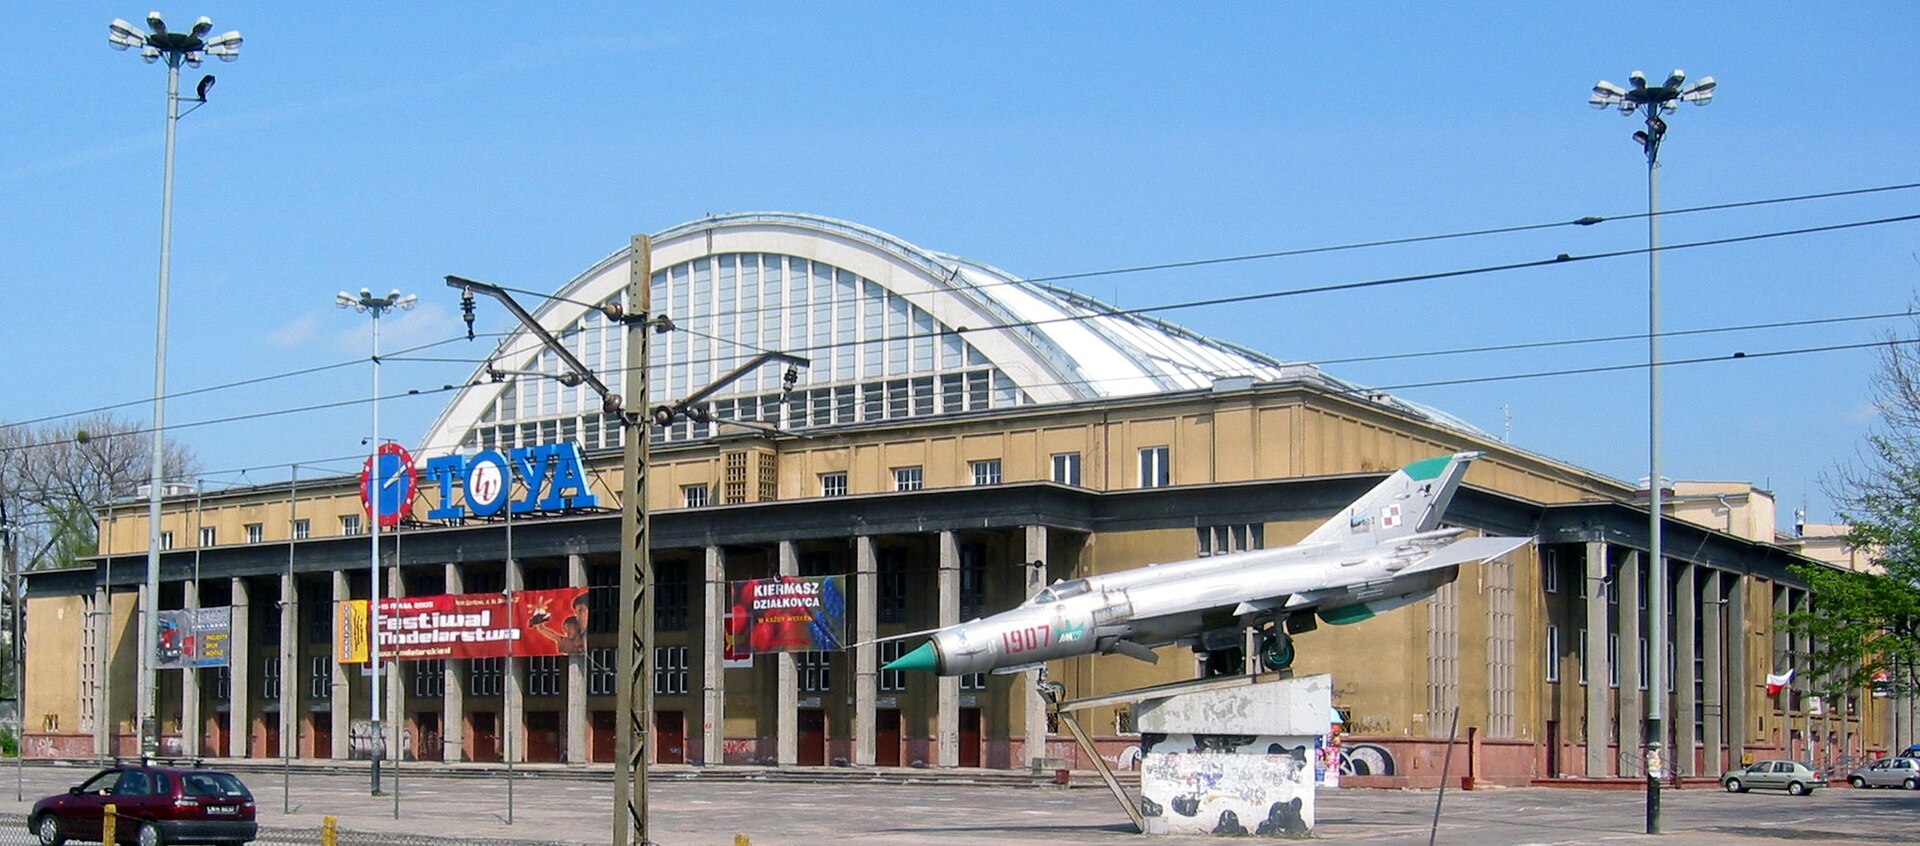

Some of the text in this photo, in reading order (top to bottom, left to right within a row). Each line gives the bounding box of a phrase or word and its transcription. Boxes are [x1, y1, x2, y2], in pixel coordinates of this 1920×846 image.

[427, 441, 598, 520] TOYA
[754, 582, 820, 597] KIERMASZ
[378, 610, 491, 630] Festiwal
[378, 627, 521, 645] Modelarstwa
[1002, 625, 1049, 654] 1907
